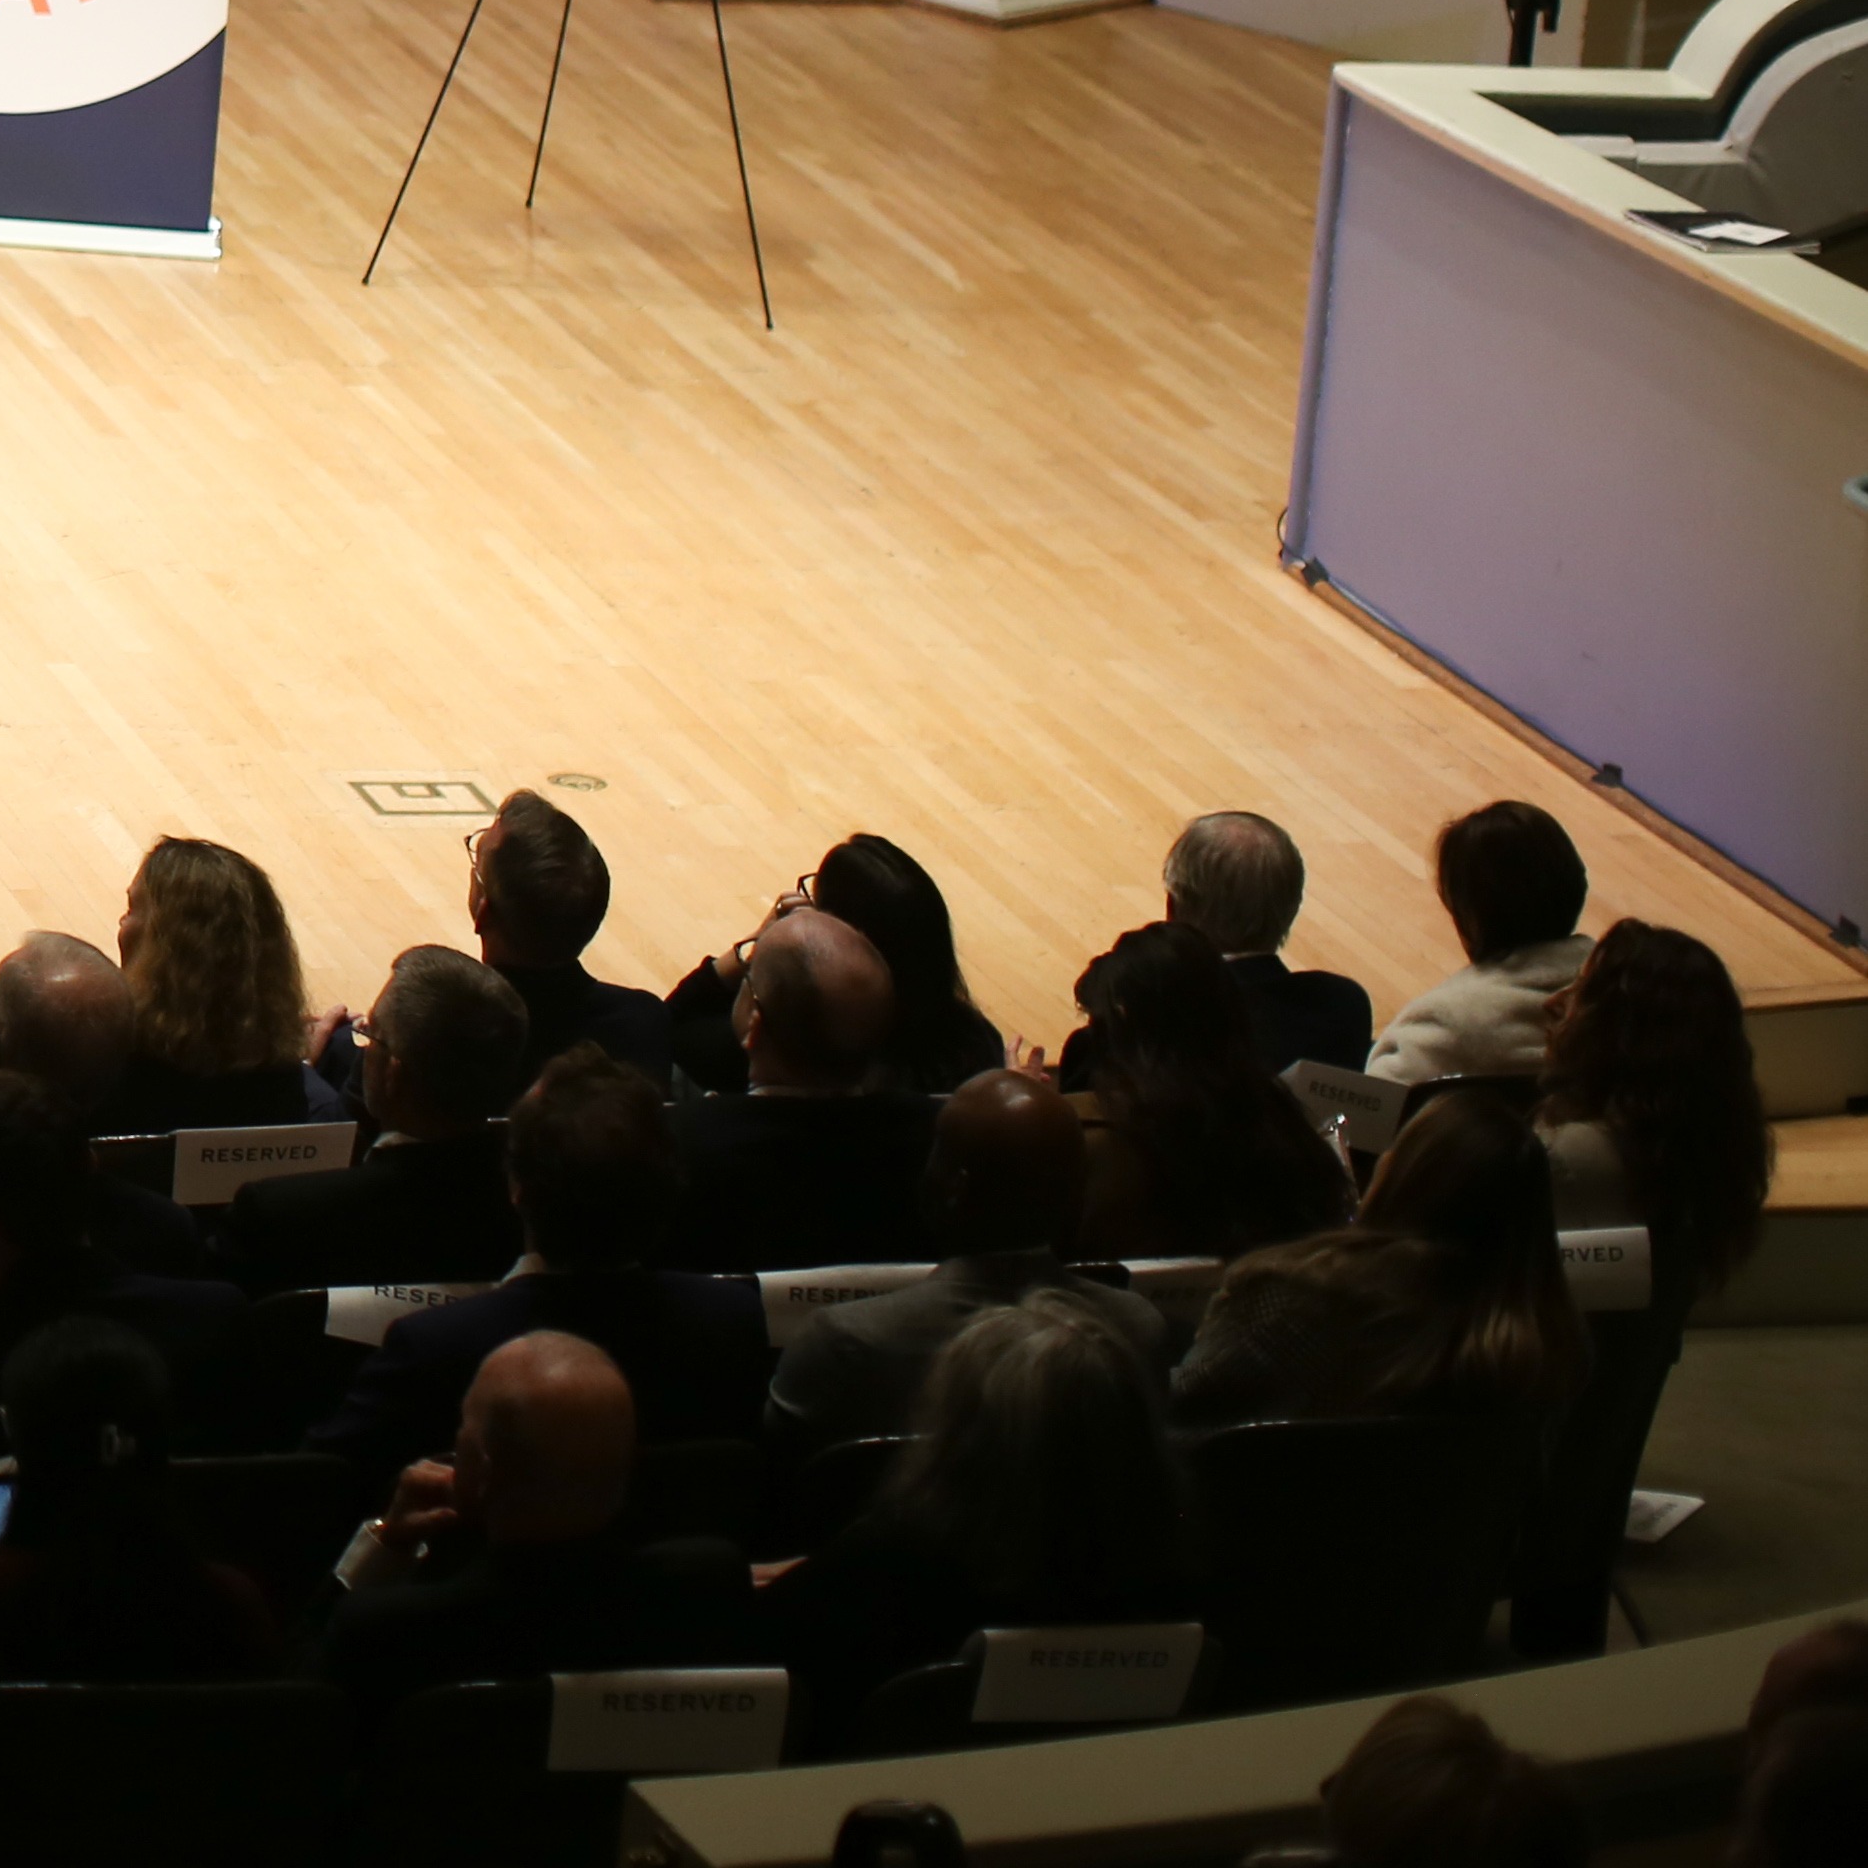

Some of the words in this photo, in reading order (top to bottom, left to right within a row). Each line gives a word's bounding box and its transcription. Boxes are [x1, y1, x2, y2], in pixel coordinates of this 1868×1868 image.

[200, 1144, 318, 1164] RESERVED
[1561, 1246, 1624, 1263] RVED
[373, 1285, 459, 1309] RESER
[1030, 1648, 1170, 1670] RESERVED
[601, 1691, 756, 1713] RESERVED
